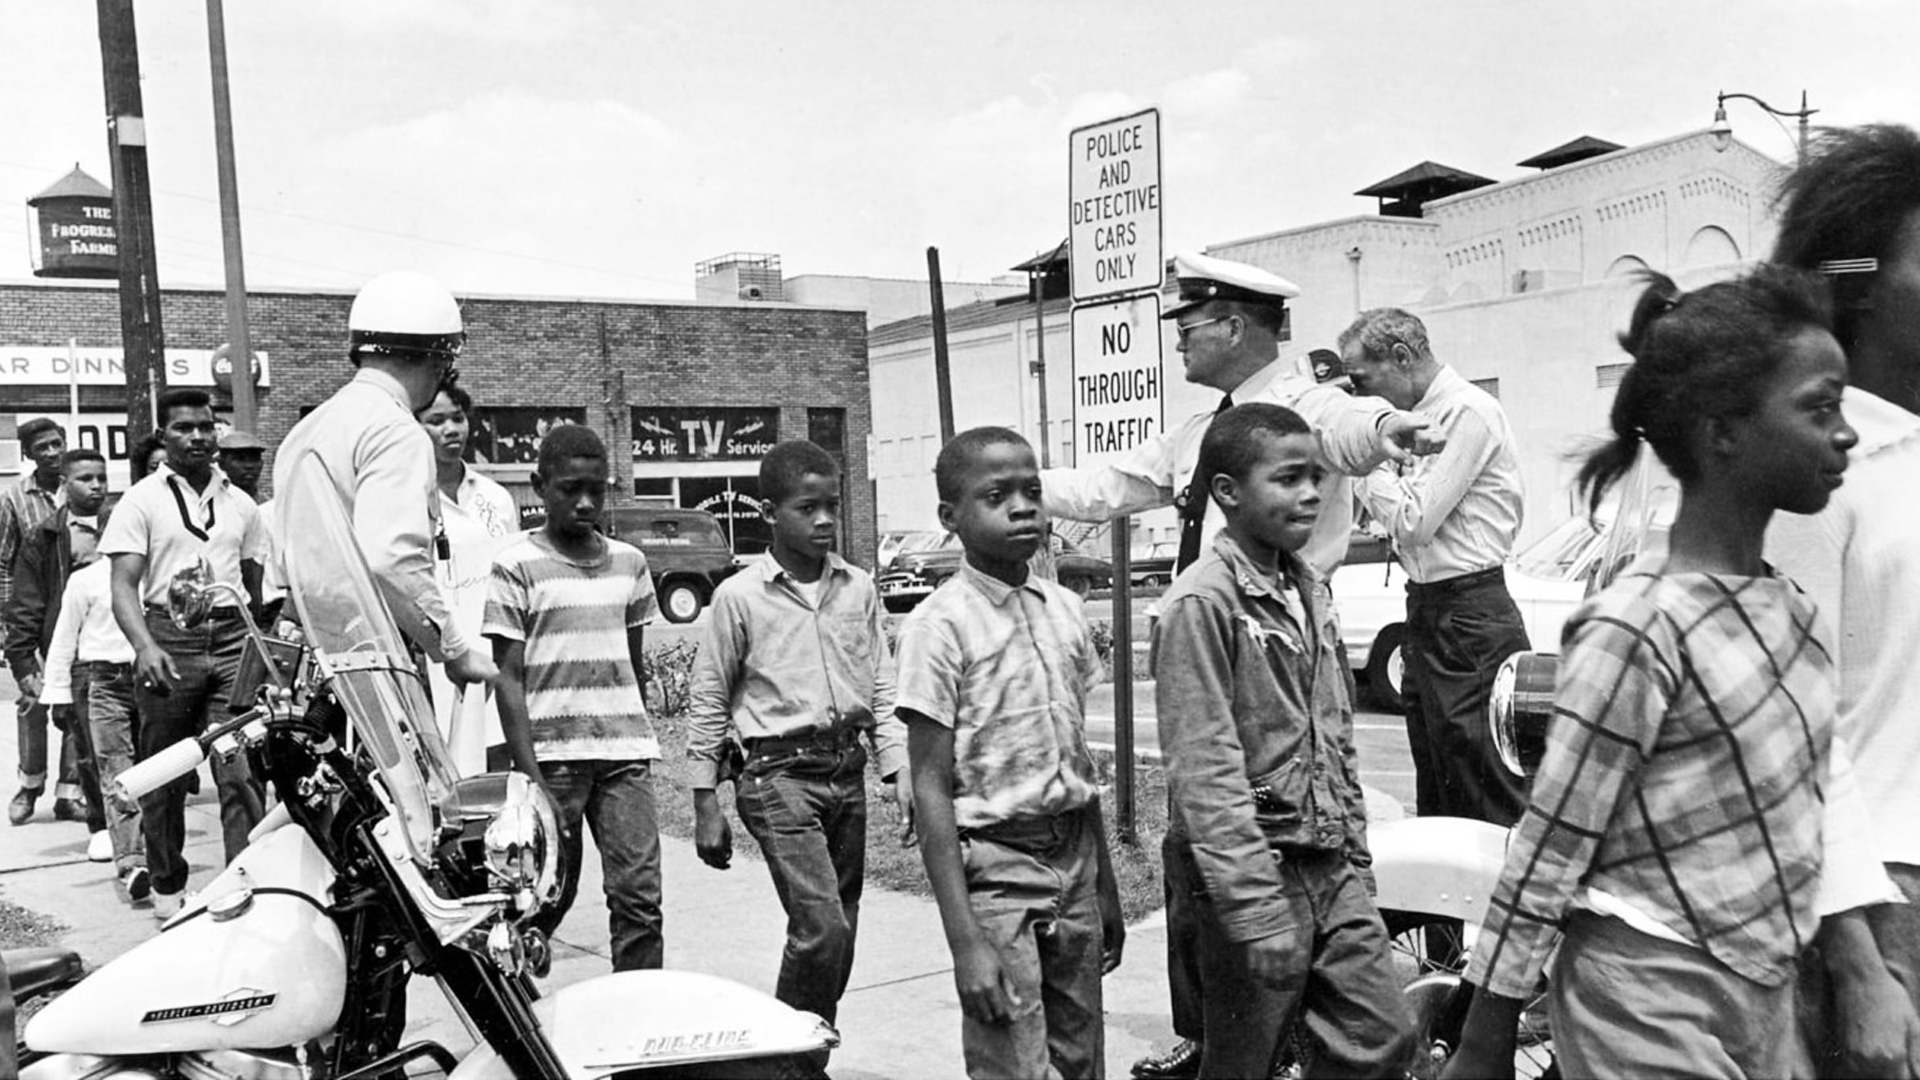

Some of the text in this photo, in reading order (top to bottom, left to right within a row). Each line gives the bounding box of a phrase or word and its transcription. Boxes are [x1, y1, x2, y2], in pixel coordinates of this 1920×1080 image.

[1086, 125, 1143, 161] POLICE
[1099, 160, 1131, 189] AND
[82, 206, 112, 219] THE
[1073, 185, 1158, 225] DETECTIVE
[70, 240, 117, 255] FARME
[1095, 222, 1136, 252] CARS
[1096, 253, 1137, 282] ONLY
[1102, 322, 1131, 356] NO
[52, 357, 190, 376] DINNS
[1078, 367, 1157, 406] THROUGH
[632, 440, 655, 455] 24
[660, 439, 678, 455] Hr.
[681, 420, 724, 454] TV
[1084, 417, 1154, 453] TRAFFIC
[721, 491, 737, 502] TV
